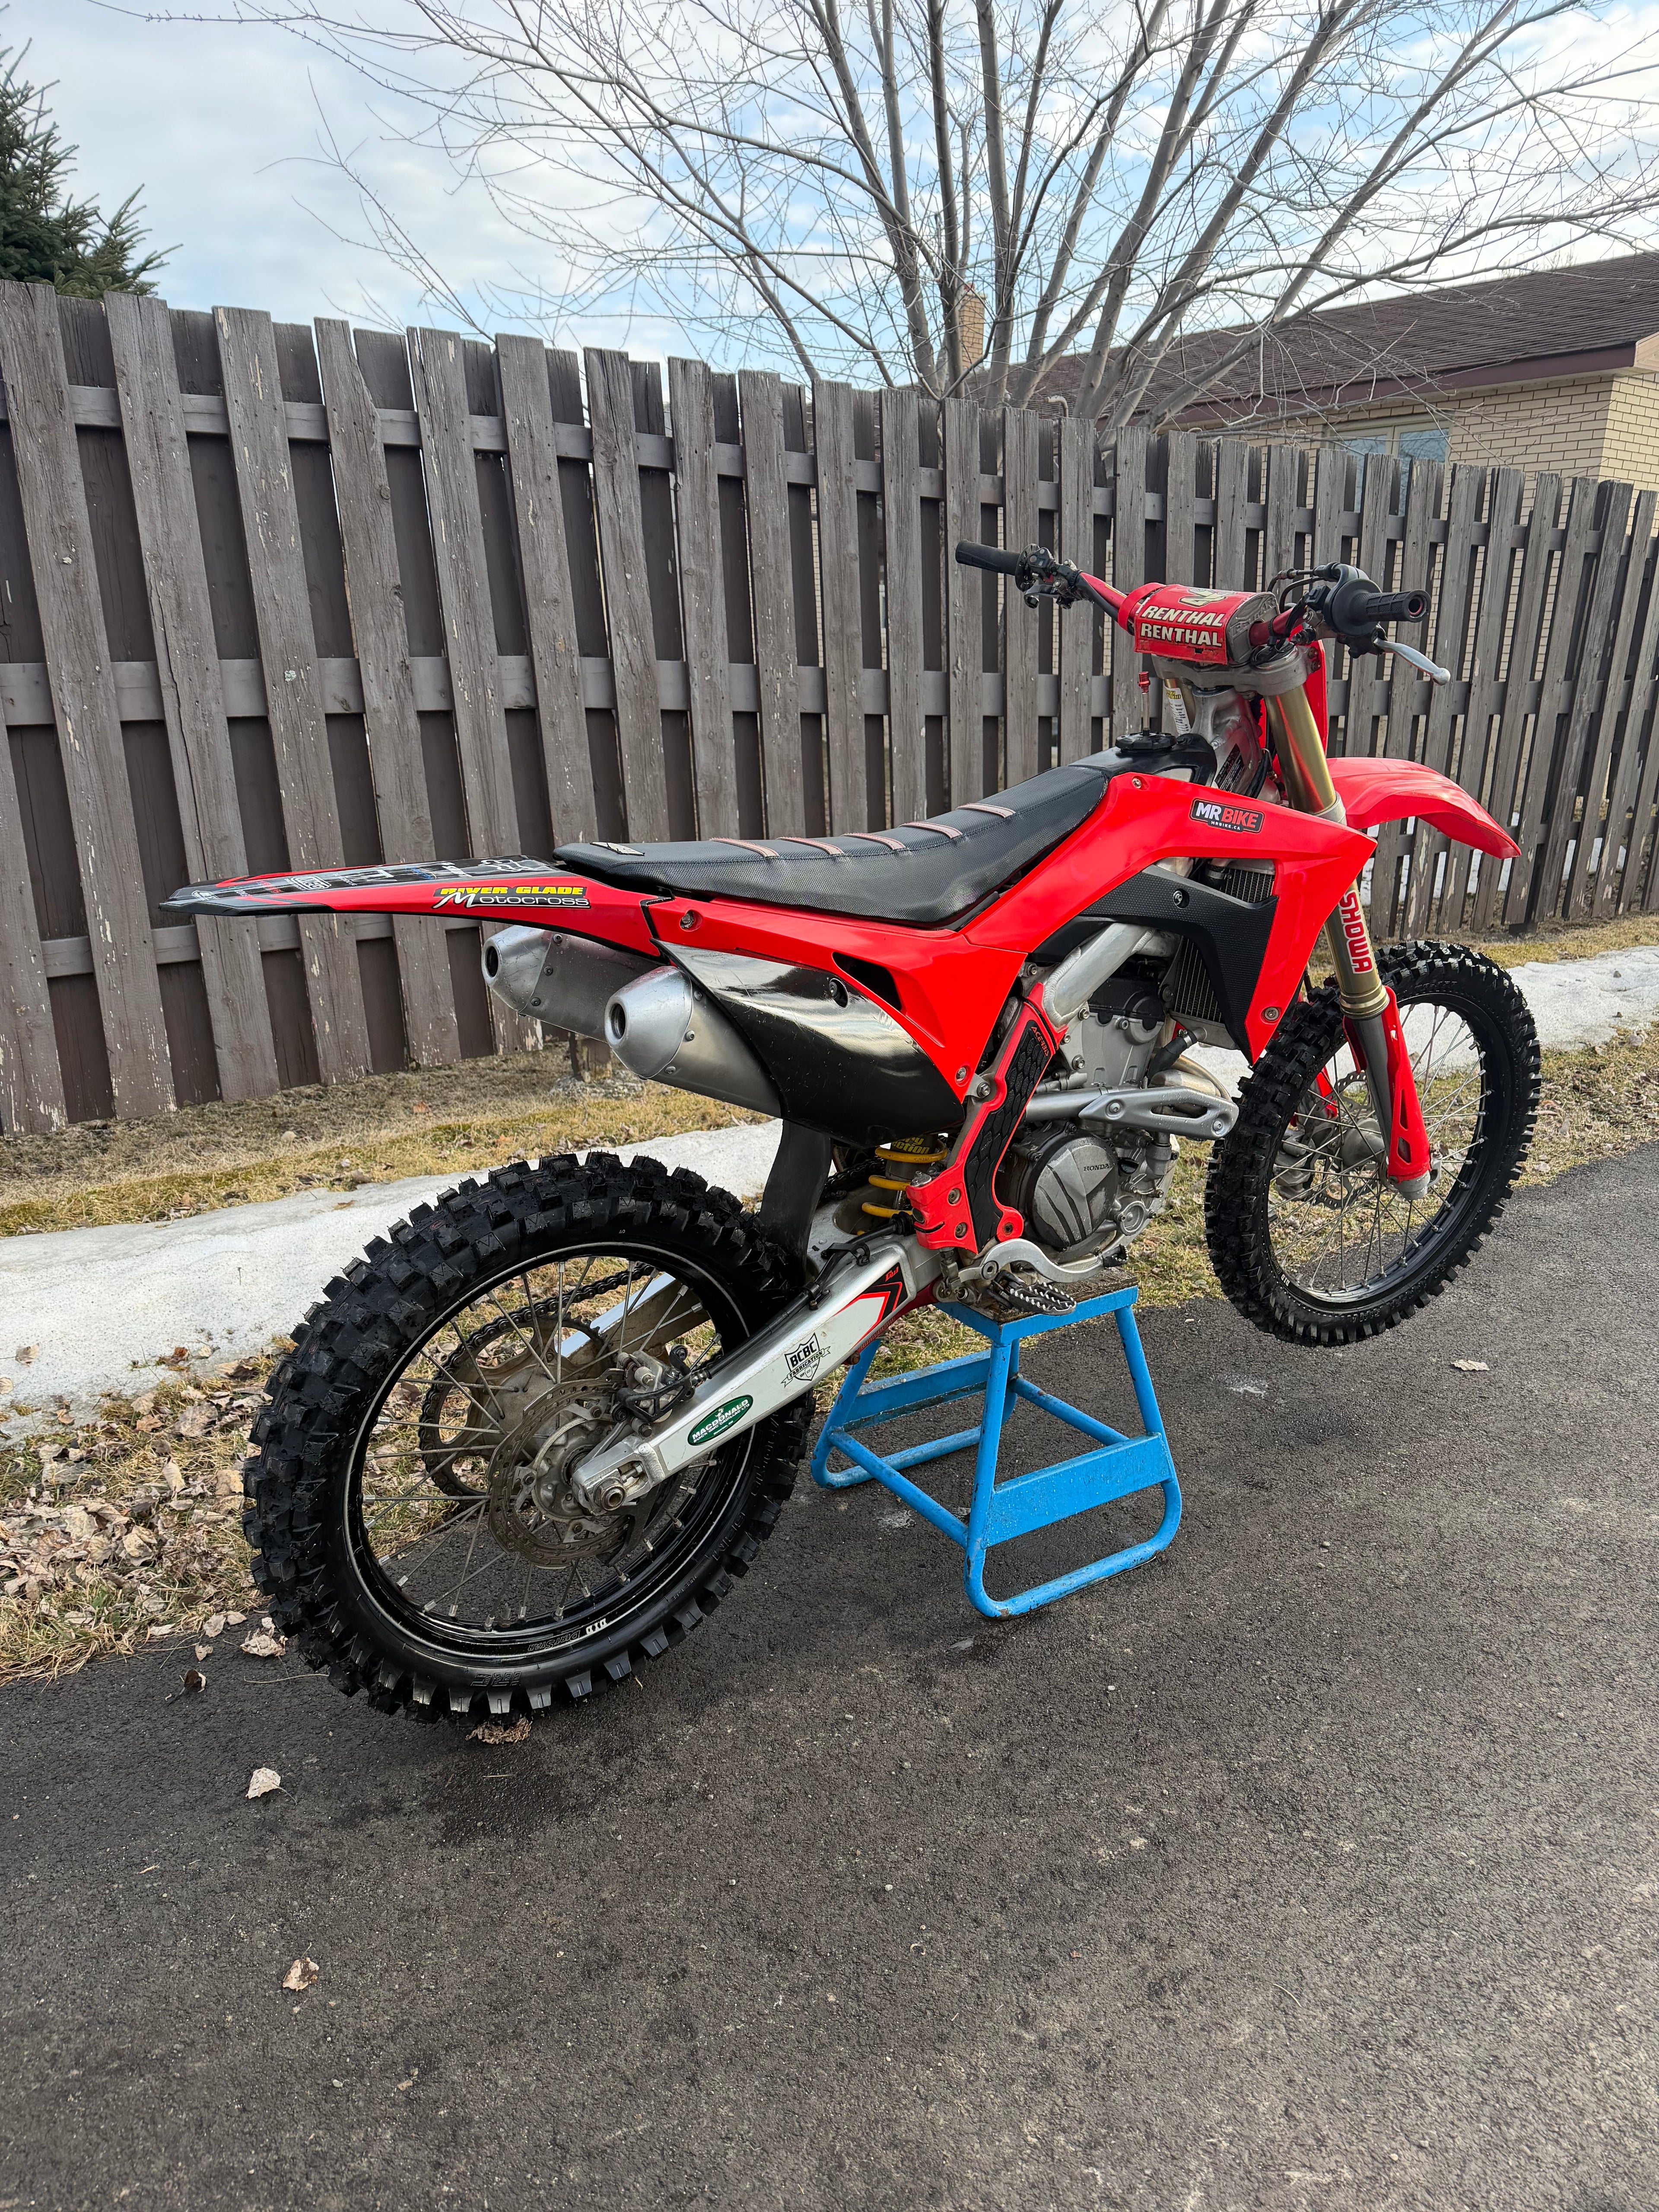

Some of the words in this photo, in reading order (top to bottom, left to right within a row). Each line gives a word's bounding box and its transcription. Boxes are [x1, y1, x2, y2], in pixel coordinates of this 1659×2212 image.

[1141, 605, 1225, 626] RENTHAL
[1141, 623, 1222, 647] RENTHAL
[433, 892, 589, 908] Motocross
[440, 887, 508, 895] RIVER
[515, 887, 583, 895] GLADE
[1339, 890, 1373, 974] SHOWA
[1083, 1163, 1109, 1171] HONDA
[789, 1351, 823, 1378] FABRICATION
[790, 1341, 817, 1368] BCBC
[692, 1399, 749, 1440] MACDONALD
